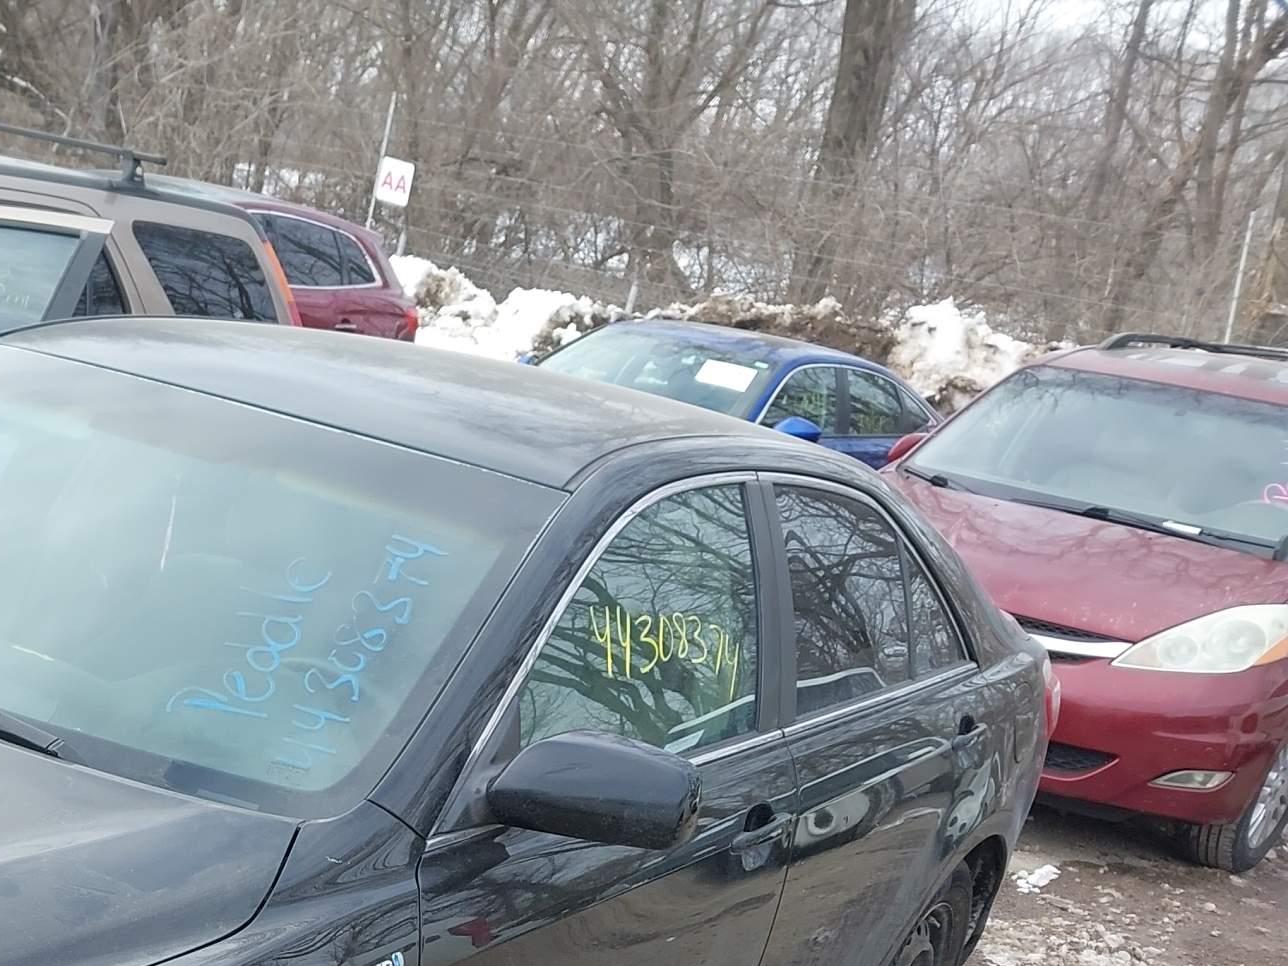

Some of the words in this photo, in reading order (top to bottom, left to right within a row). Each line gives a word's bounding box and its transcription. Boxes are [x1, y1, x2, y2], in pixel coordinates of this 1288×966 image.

[381, 170, 407, 195] AA
[273, 534, 449, 769] 44308374
[589, 605, 740, 702] 44308374
